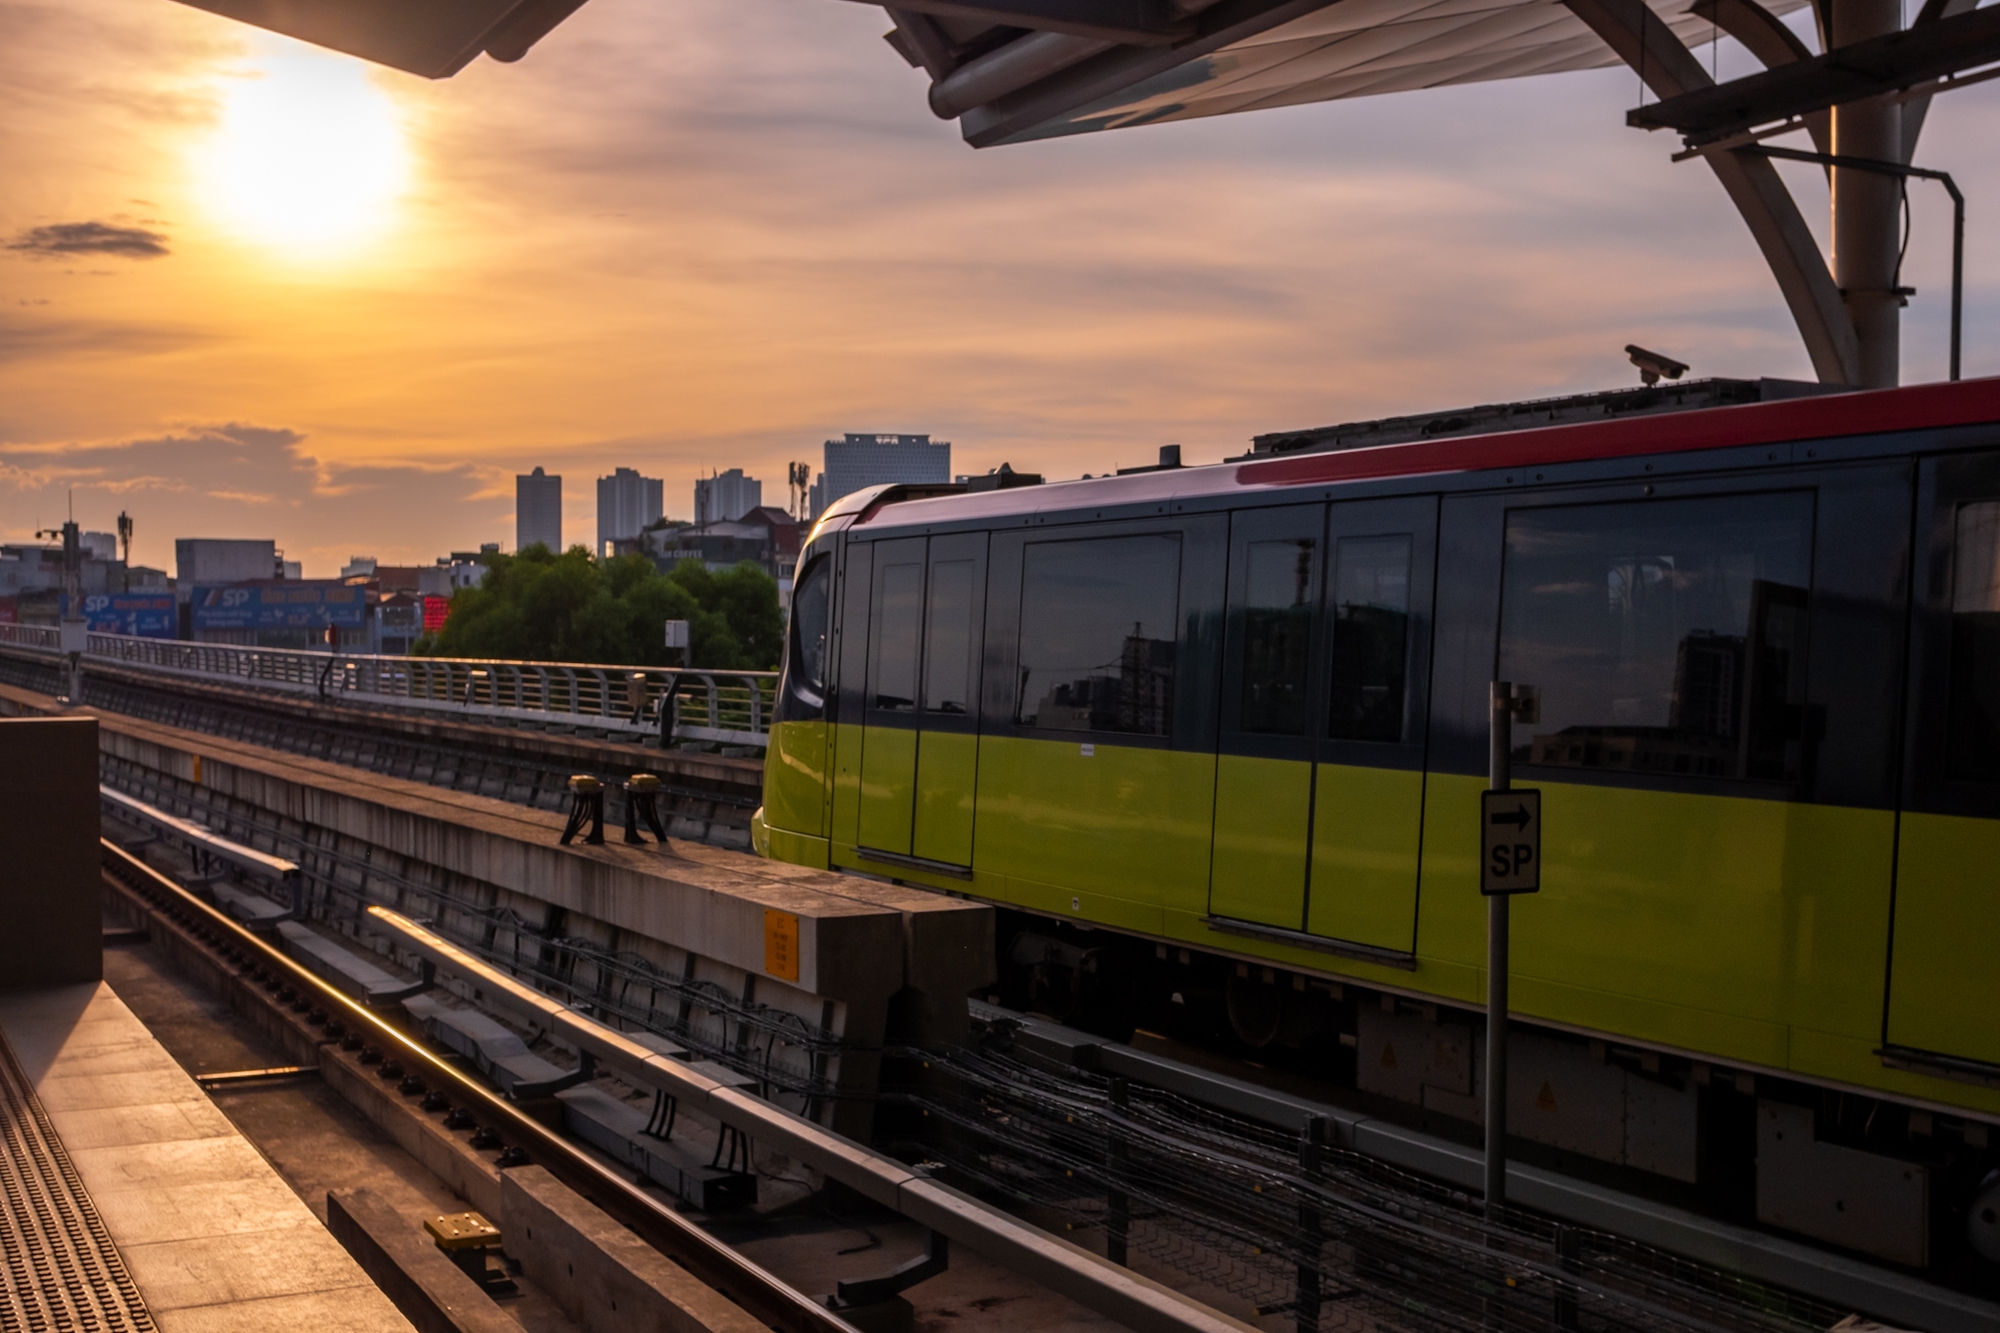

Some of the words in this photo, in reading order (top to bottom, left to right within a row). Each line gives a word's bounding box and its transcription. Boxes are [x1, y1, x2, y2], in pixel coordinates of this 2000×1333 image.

[86, 596, 110, 611] SP
[223, 588, 249, 606] SP
[1491, 844, 1533, 877] SP
